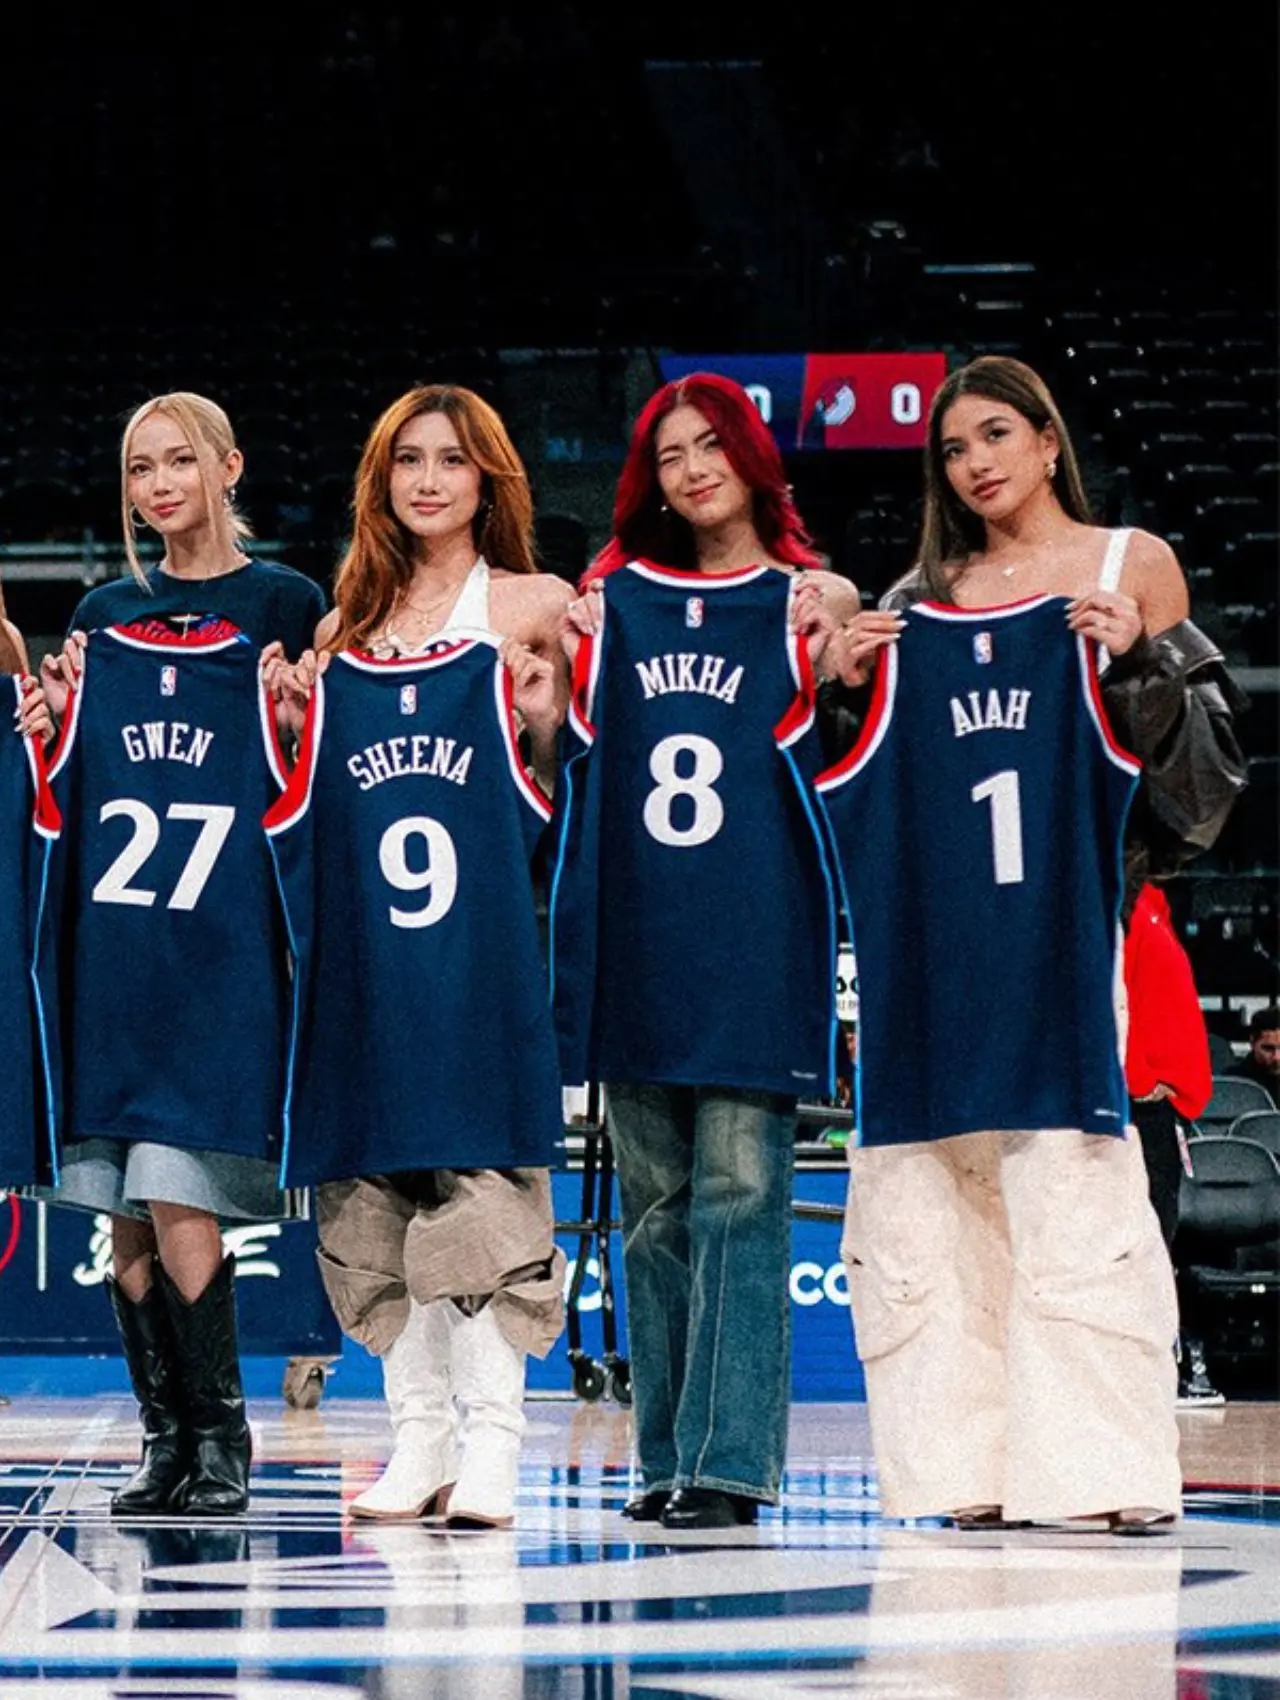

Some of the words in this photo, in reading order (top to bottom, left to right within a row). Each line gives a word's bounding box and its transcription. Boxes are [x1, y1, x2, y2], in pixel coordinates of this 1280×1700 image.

[891, 384, 921, 424] 0
[635, 653, 744, 704] MIKHA
[950, 689, 1031, 737] AIAH
[121, 721, 214, 767] GWEN
[347, 735, 474, 791] SHEENA
[643, 733, 724, 847] 8
[92, 798, 236, 911] 27
[971, 770, 1024, 884] 1
[379, 816, 458, 929] 9
